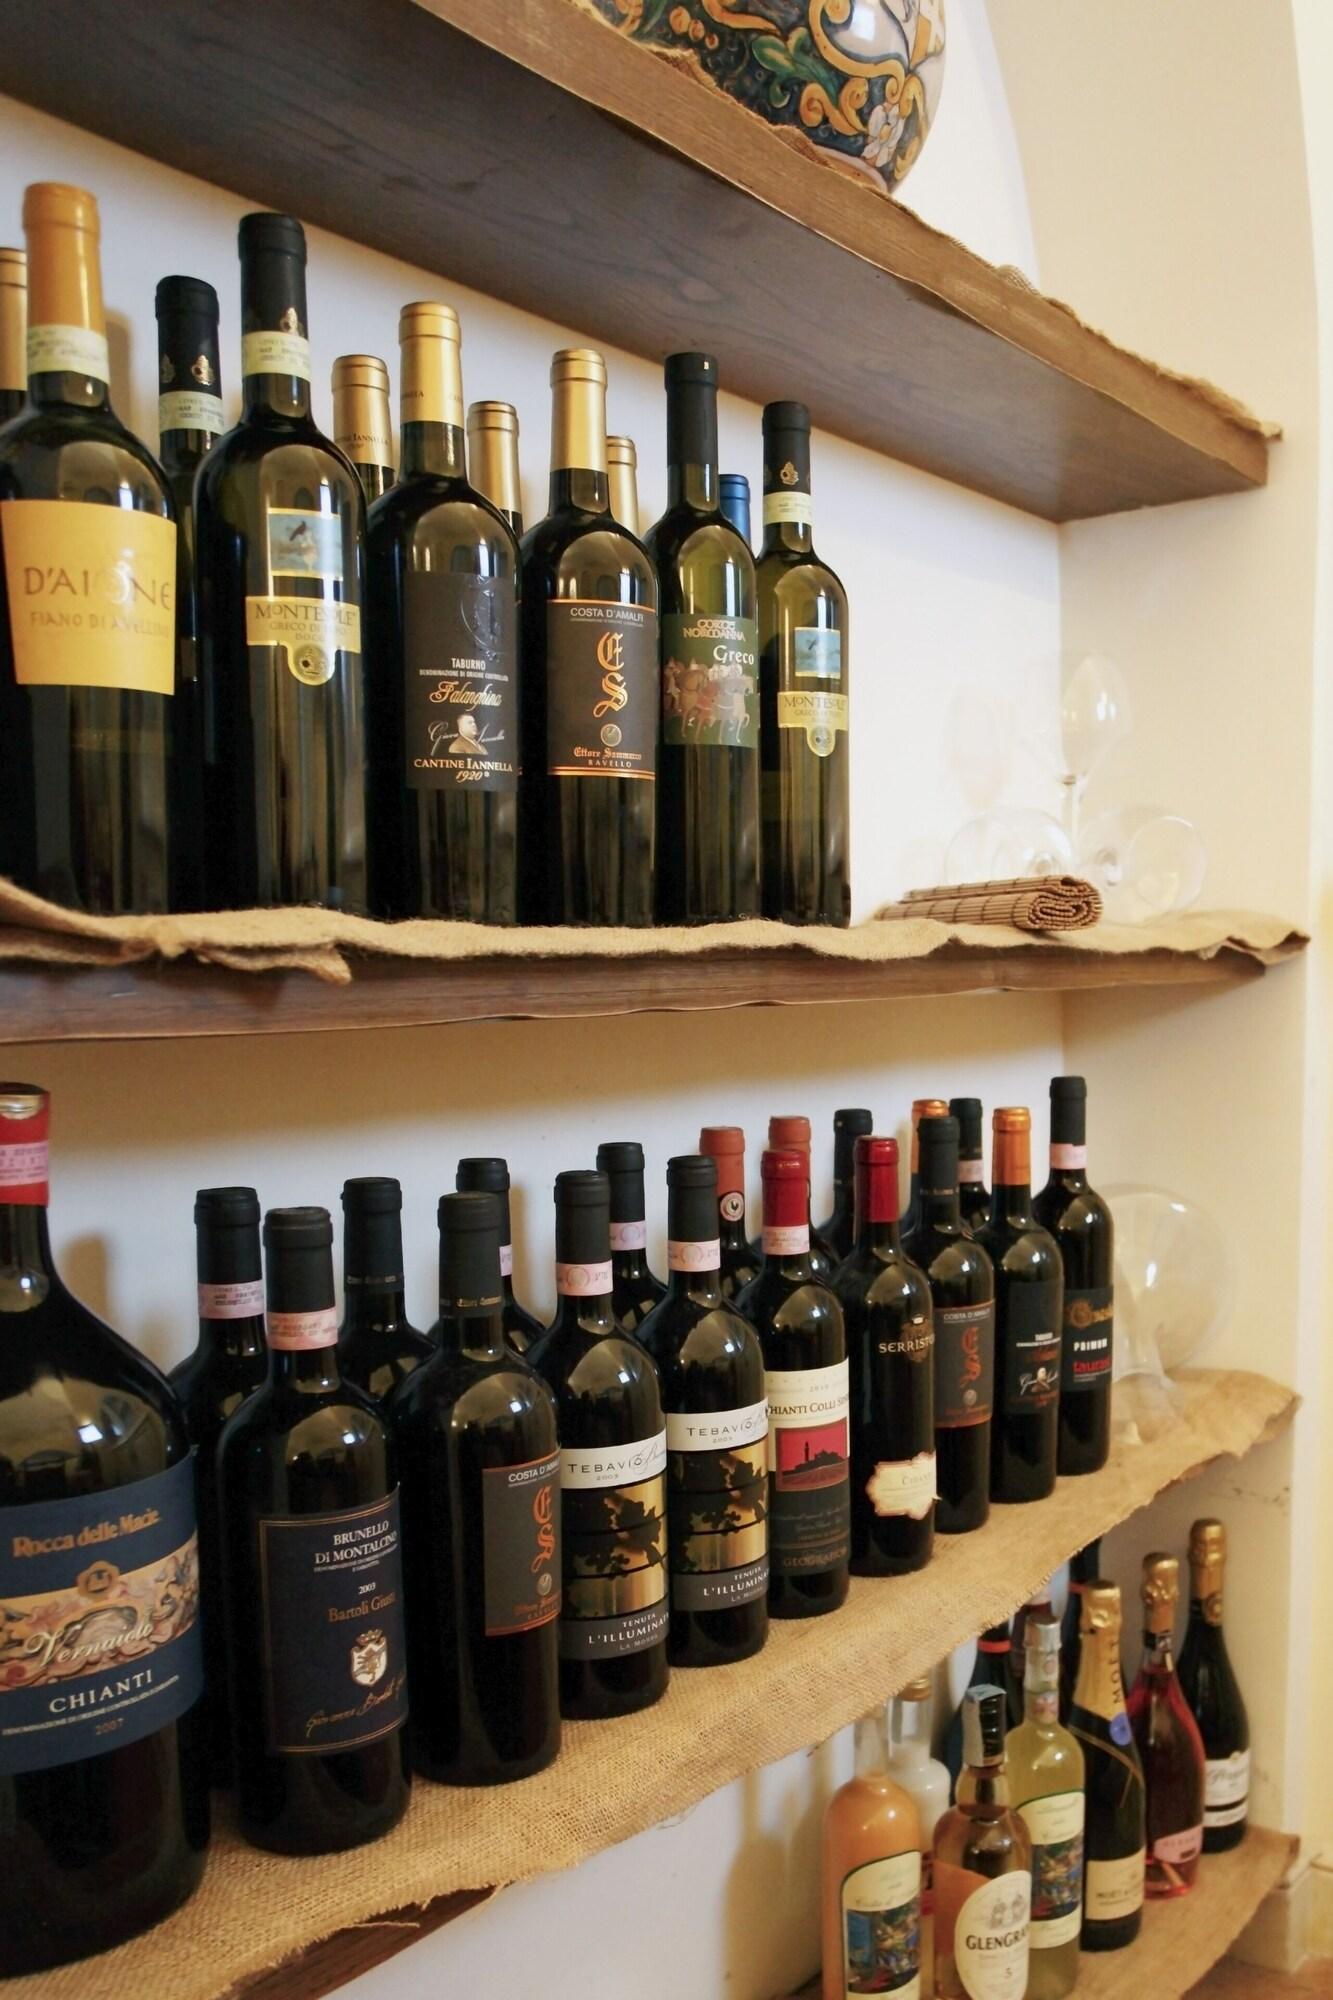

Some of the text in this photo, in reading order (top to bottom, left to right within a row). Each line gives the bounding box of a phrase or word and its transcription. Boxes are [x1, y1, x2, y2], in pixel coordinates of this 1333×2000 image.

[24, 566, 171, 611] D'AINE
[30, 610, 83, 627] FIANO
[89, 613, 106, 629] DI
[255, 603, 356, 626] MONTELE
[570, 607, 644, 622] COSTA D'AMALFI
[451, 658, 486, 670] TABURNO
[713, 644, 755, 666] Greco
[429, 680, 503, 712] Falanghina
[414, 757, 513, 772] CANTINE IANNELLA
[588, 759, 632, 769] RAVELLO
[768, 1405, 807, 1415] HIANTI
[508, 1469, 538, 1483] COSTA
[12, 1534, 75, 1558] Rocca
[77, 1521, 118, 1547] delle
[332, 1519, 390, 1547] BRUNELLO
[314, 1552, 330, 1565] DI
[784, 1545, 848, 1568] GEOGRAF
[328, 1600, 369, 1623] Bartoli
[622, 1612, 656, 1629] TENUTA
[49, 1669, 152, 1713] CHIANTI
